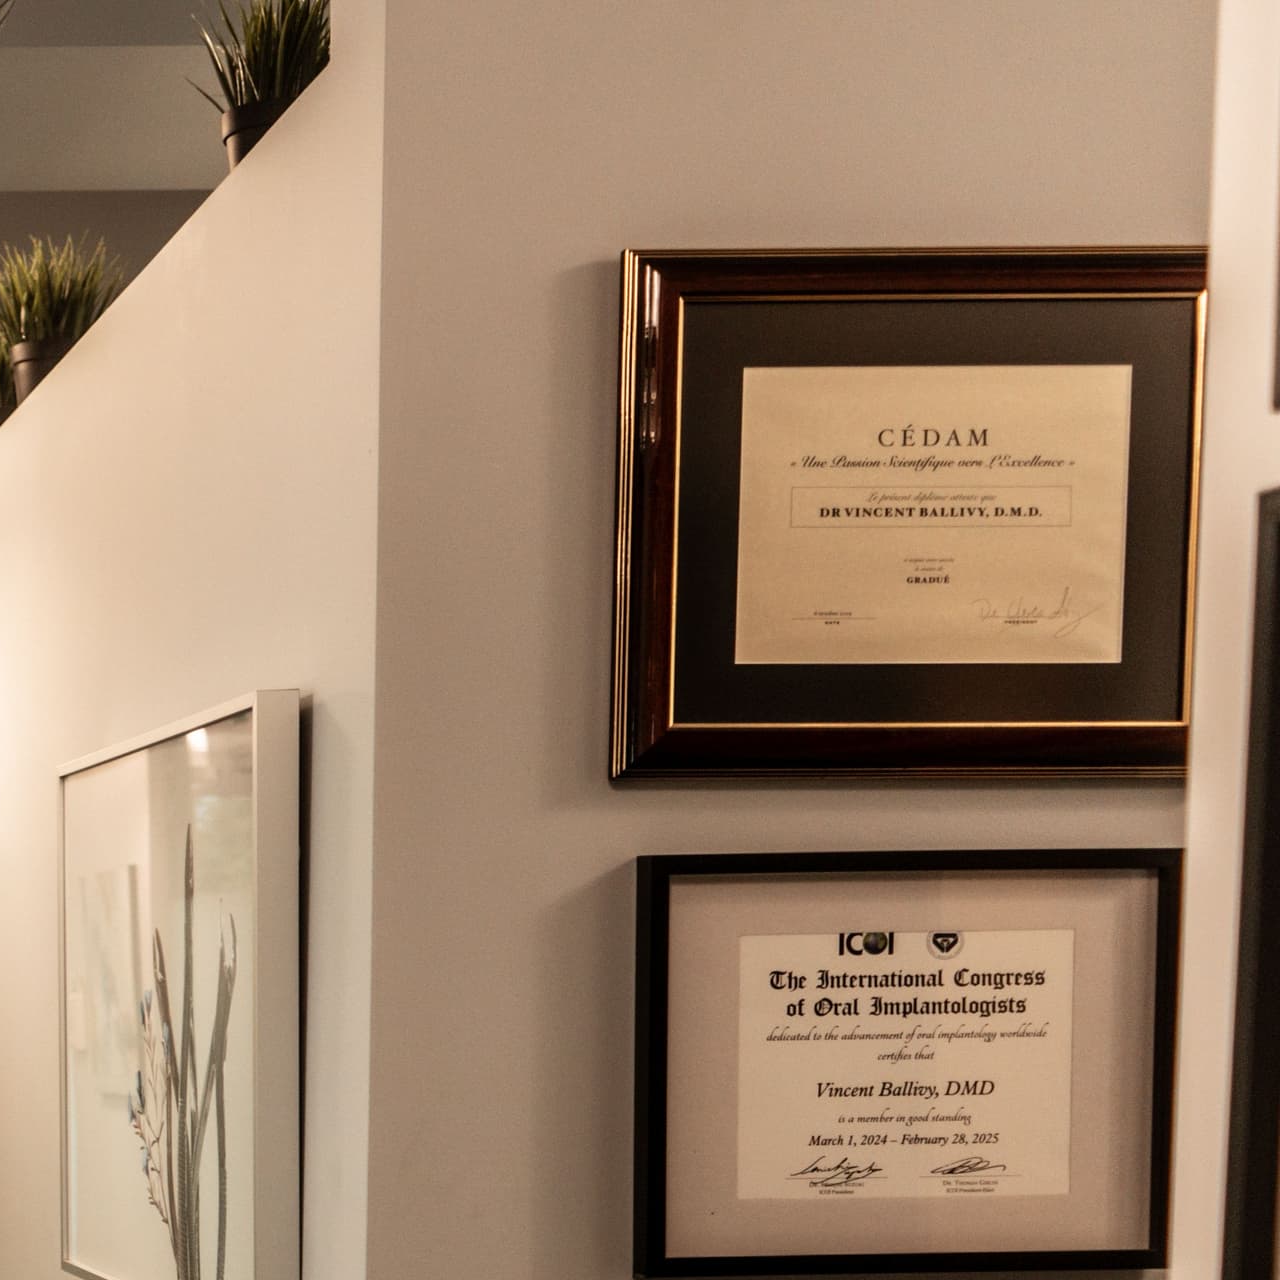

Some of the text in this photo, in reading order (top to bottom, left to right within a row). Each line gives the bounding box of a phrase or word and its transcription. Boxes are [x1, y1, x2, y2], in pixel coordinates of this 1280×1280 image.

[877, 424, 989, 447] CÉDAM
[801, 455, 827, 468] Une
[820, 506, 1042, 518] DR VINCENT BALLIVY, D.M.D.
[769, 968, 1046, 991] The International Congress
[786, 996, 1026, 1018] of Oral Implantologists
[766, 1026, 812, 1042] dedicated
[813, 1032, 822, 1042] to
[824, 1026, 839, 1041] the
[840, 1025, 903, 1041] advancement
[917, 1024, 936, 1039] oral
[938, 1023, 997, 1042] implantology
[999, 1022, 1050, 1038] worldwide
[877, 1045, 935, 1064] certifies that
[816, 1080, 995, 1099] Vincent Ballivy, DMD
[857, 1107, 894, 1124] member
[905, 1107, 930, 1126] good
[931, 1106, 972, 1125] standing
[808, 1134, 843, 1147] March
[860, 1134, 888, 1146] 2024
[901, 1133, 949, 1147] February
[952, 1133, 970, 1146] 28,
[972, 1133, 999, 1145] 2025
